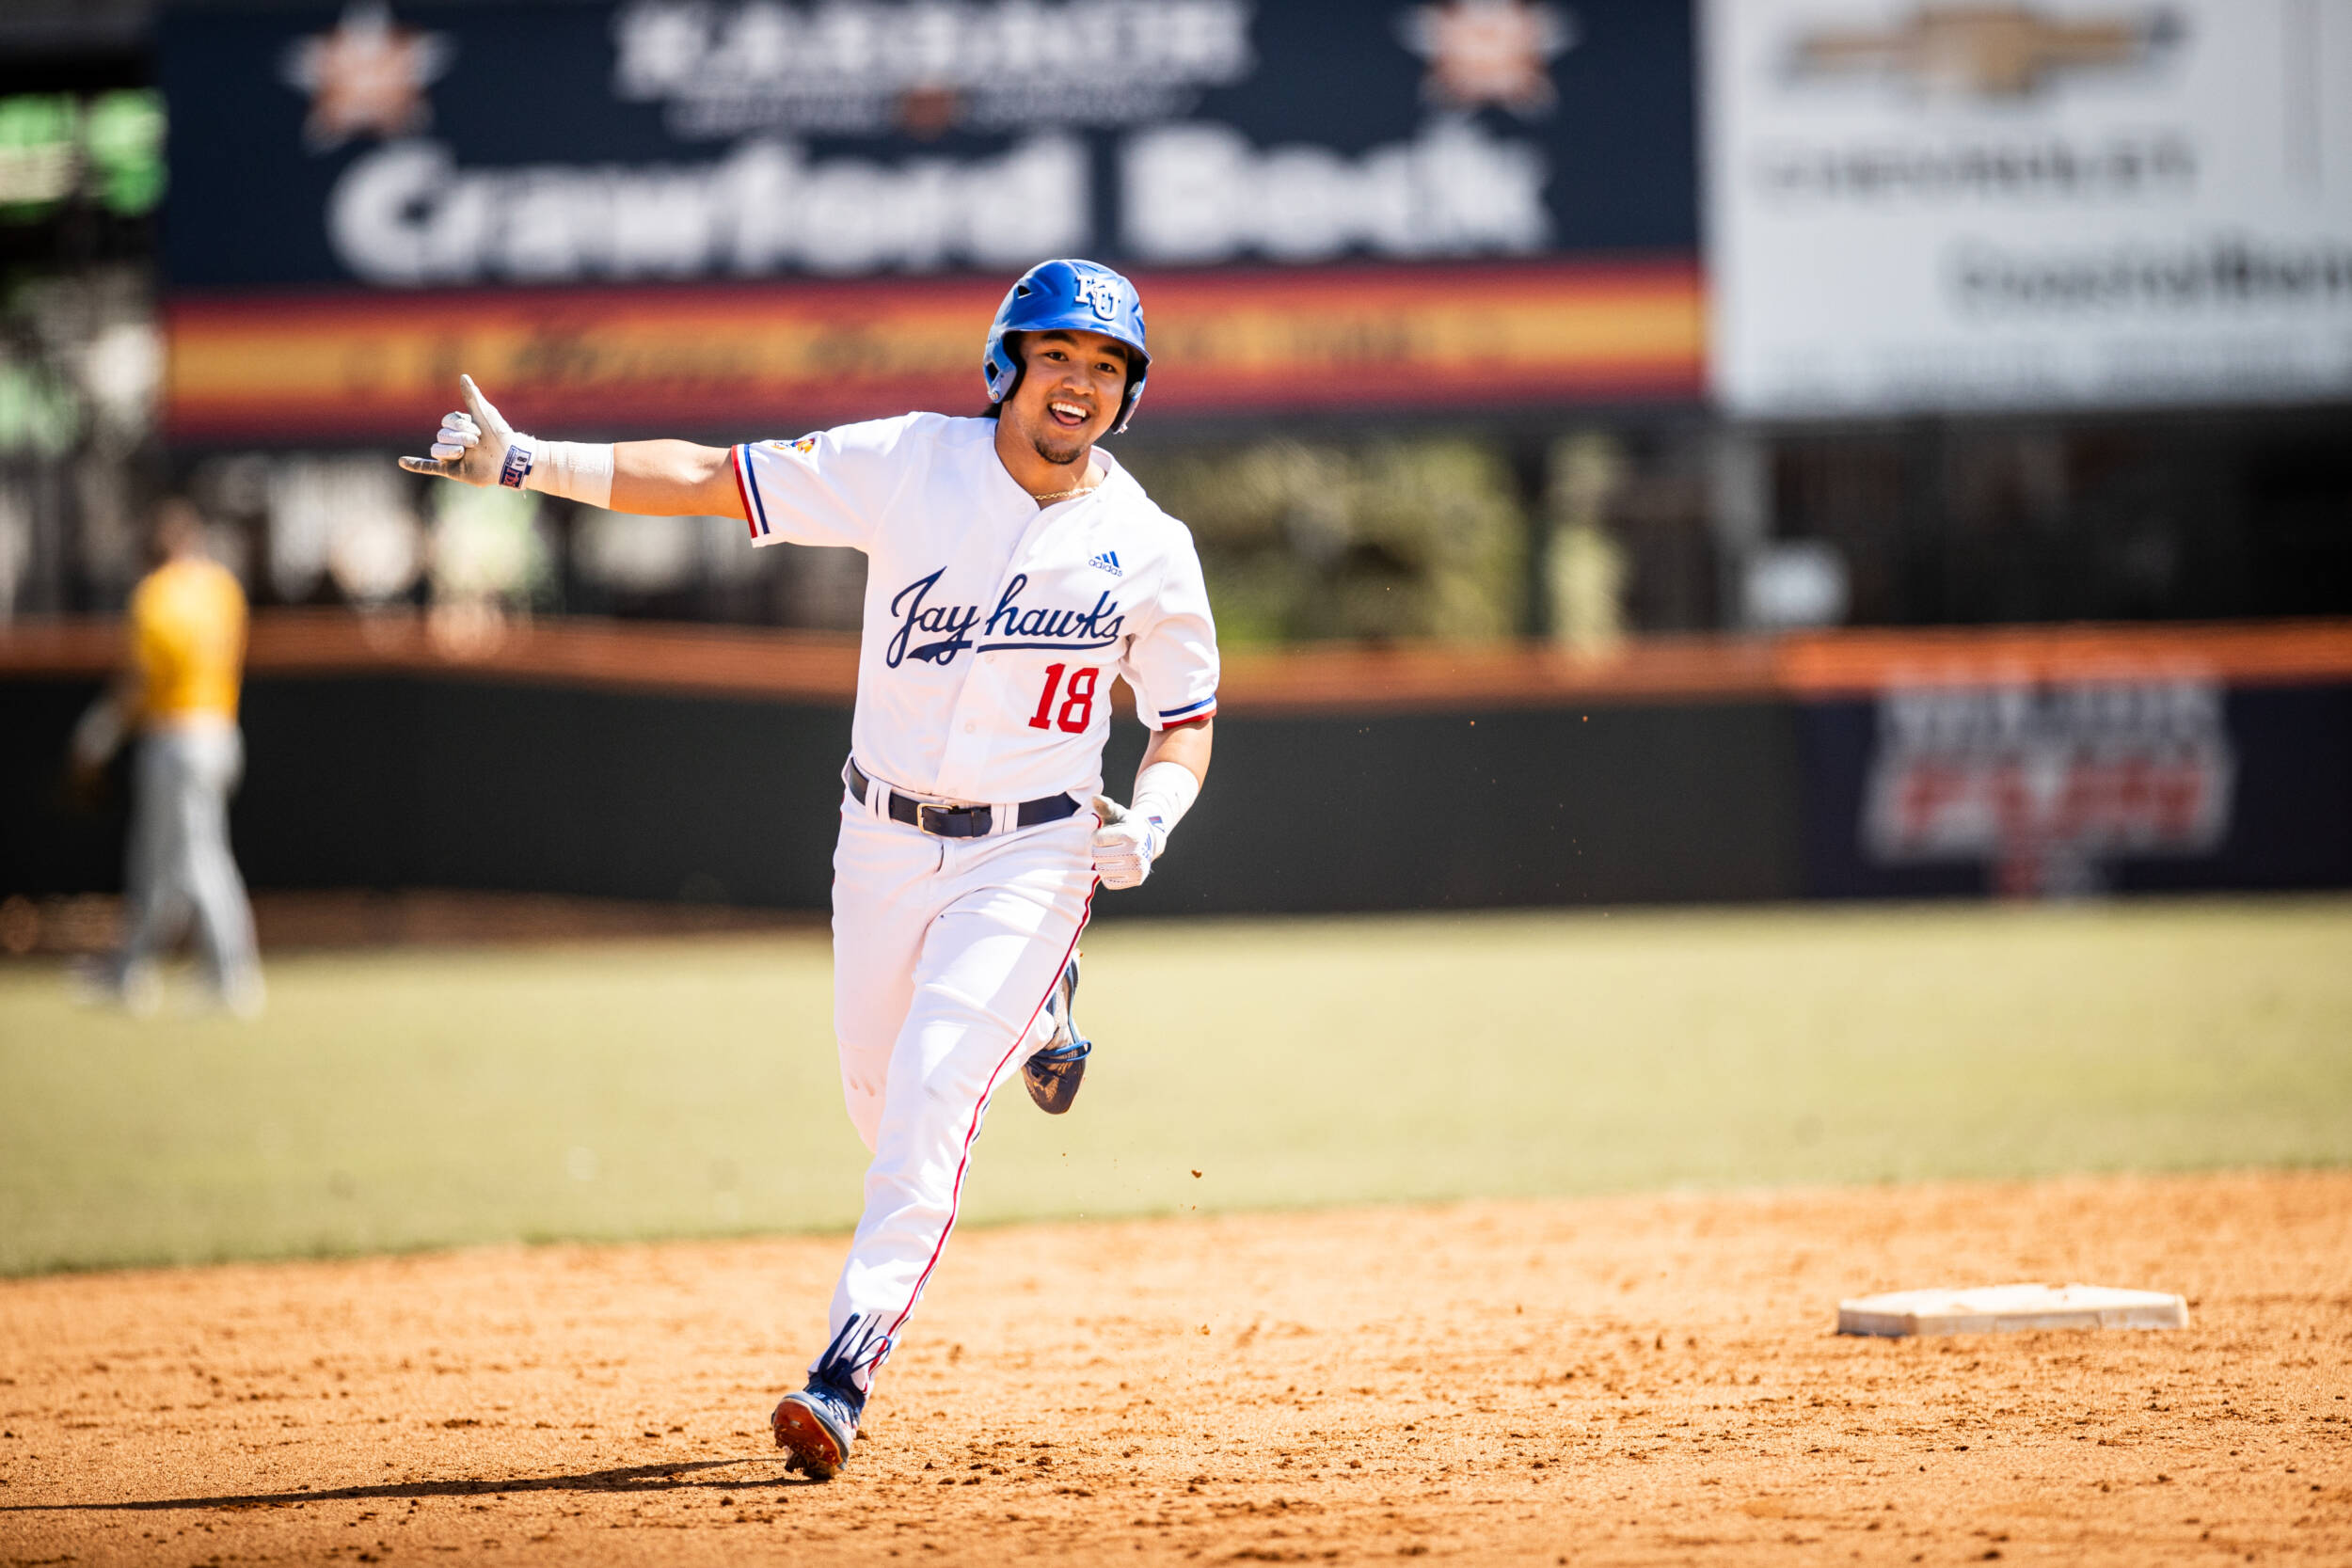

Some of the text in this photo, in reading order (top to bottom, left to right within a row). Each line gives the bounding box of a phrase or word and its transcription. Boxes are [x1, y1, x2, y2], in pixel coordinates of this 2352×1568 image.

[329, 119, 1545, 280] Crawford Bock
[1074, 275, 1120, 321] KU
[1089, 559, 1122, 577] adidas
[886, 565, 1125, 669] Jayhawks
[1028, 663, 1099, 734] 18
